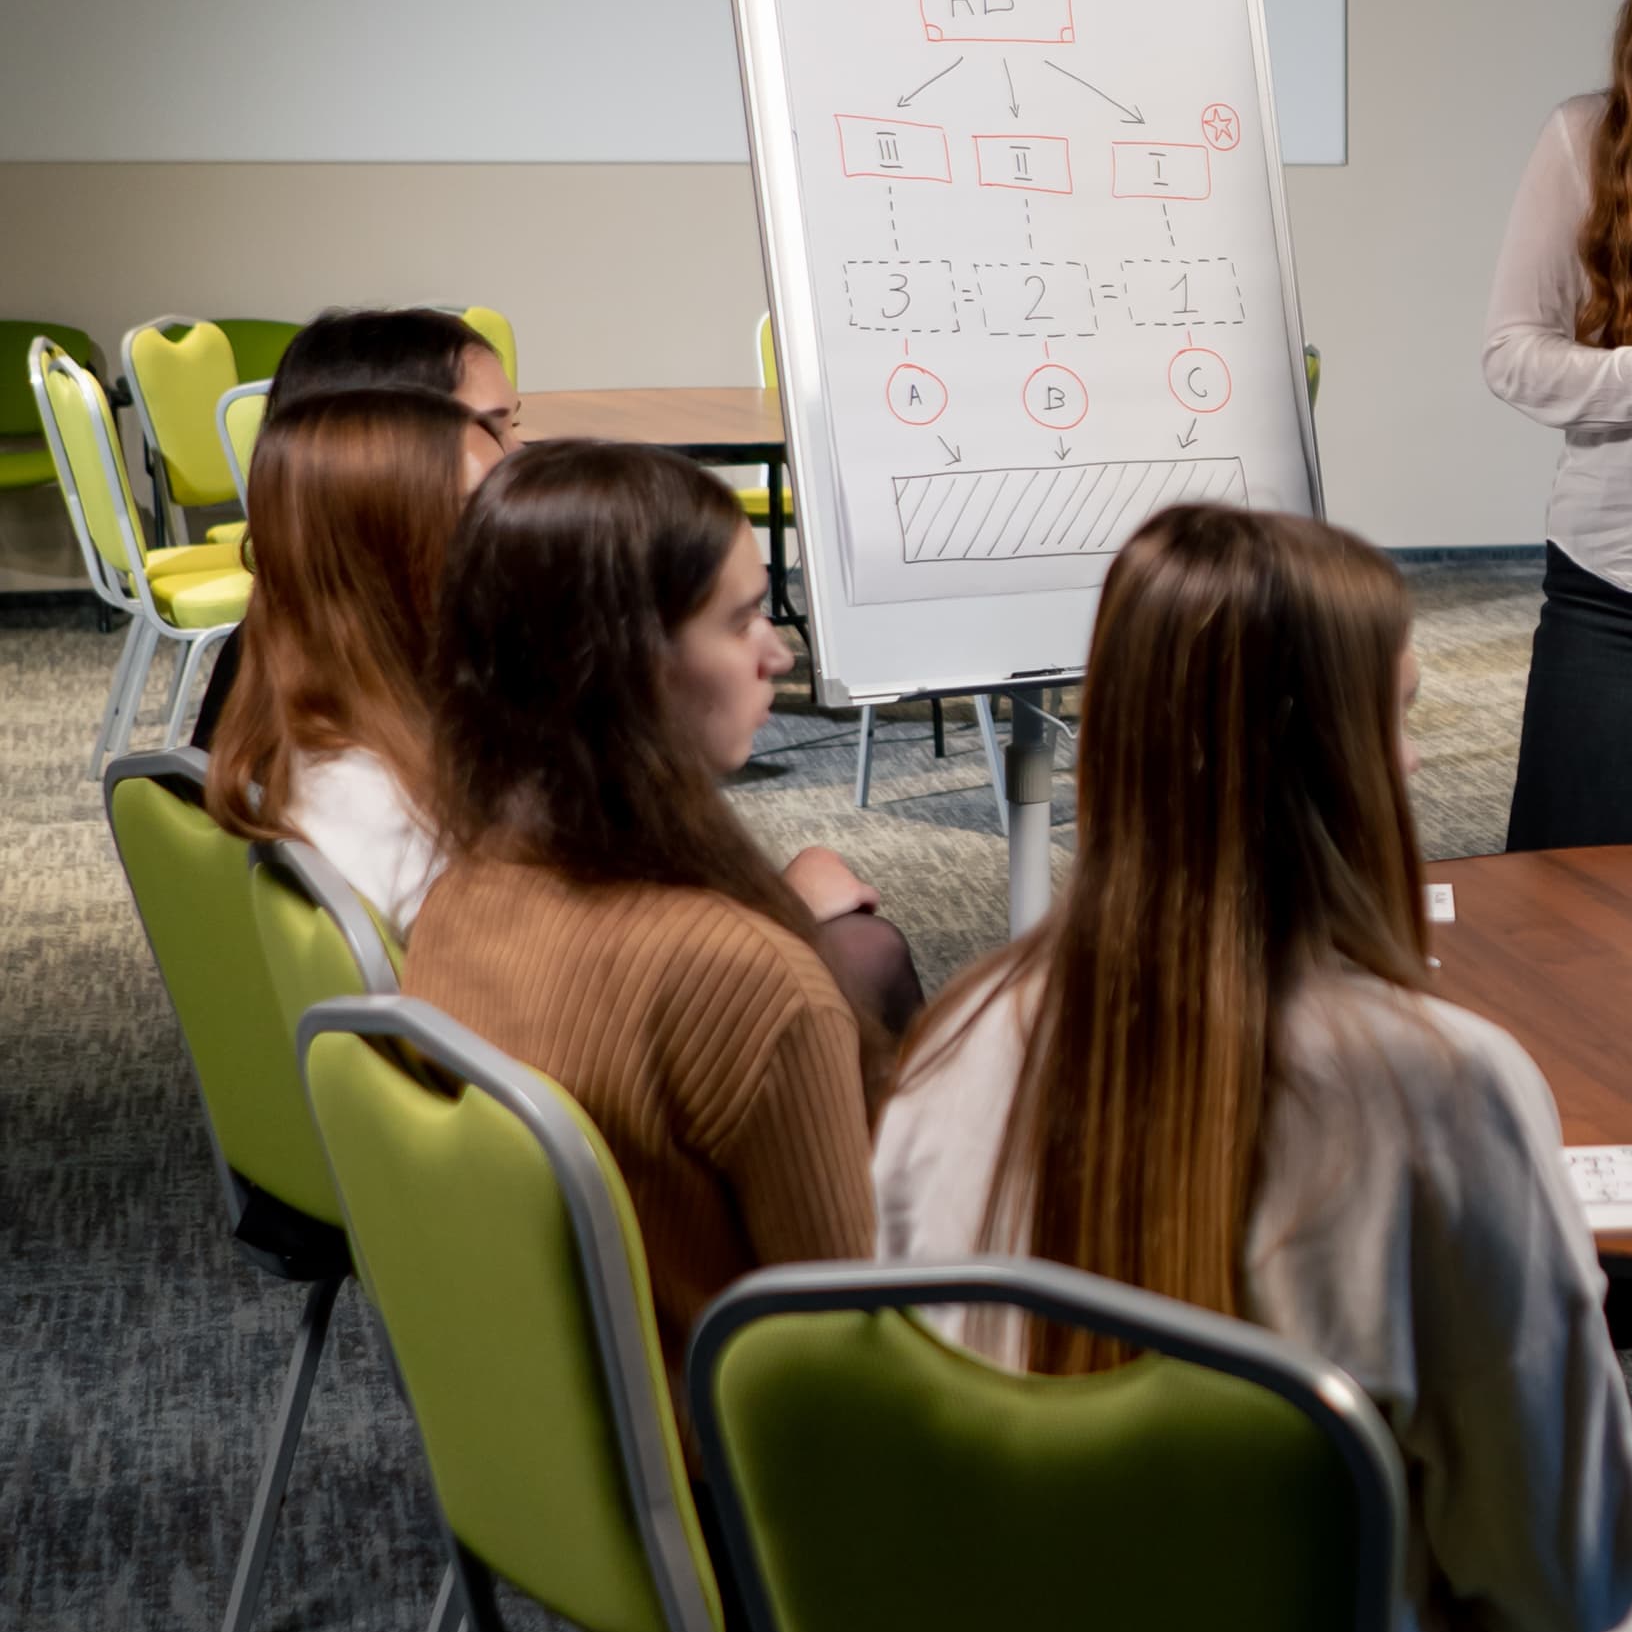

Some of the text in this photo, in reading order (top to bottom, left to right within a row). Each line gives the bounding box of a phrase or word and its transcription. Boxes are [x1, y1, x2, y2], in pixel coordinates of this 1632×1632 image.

[881, 273, 911, 319] 3
[1024, 275, 1055, 321] 2
[1169, 273, 1199, 314] 1
[909, 383, 923, 407] A
[1187, 366, 1208, 398] C
[1043, 385, 1066, 411] B
